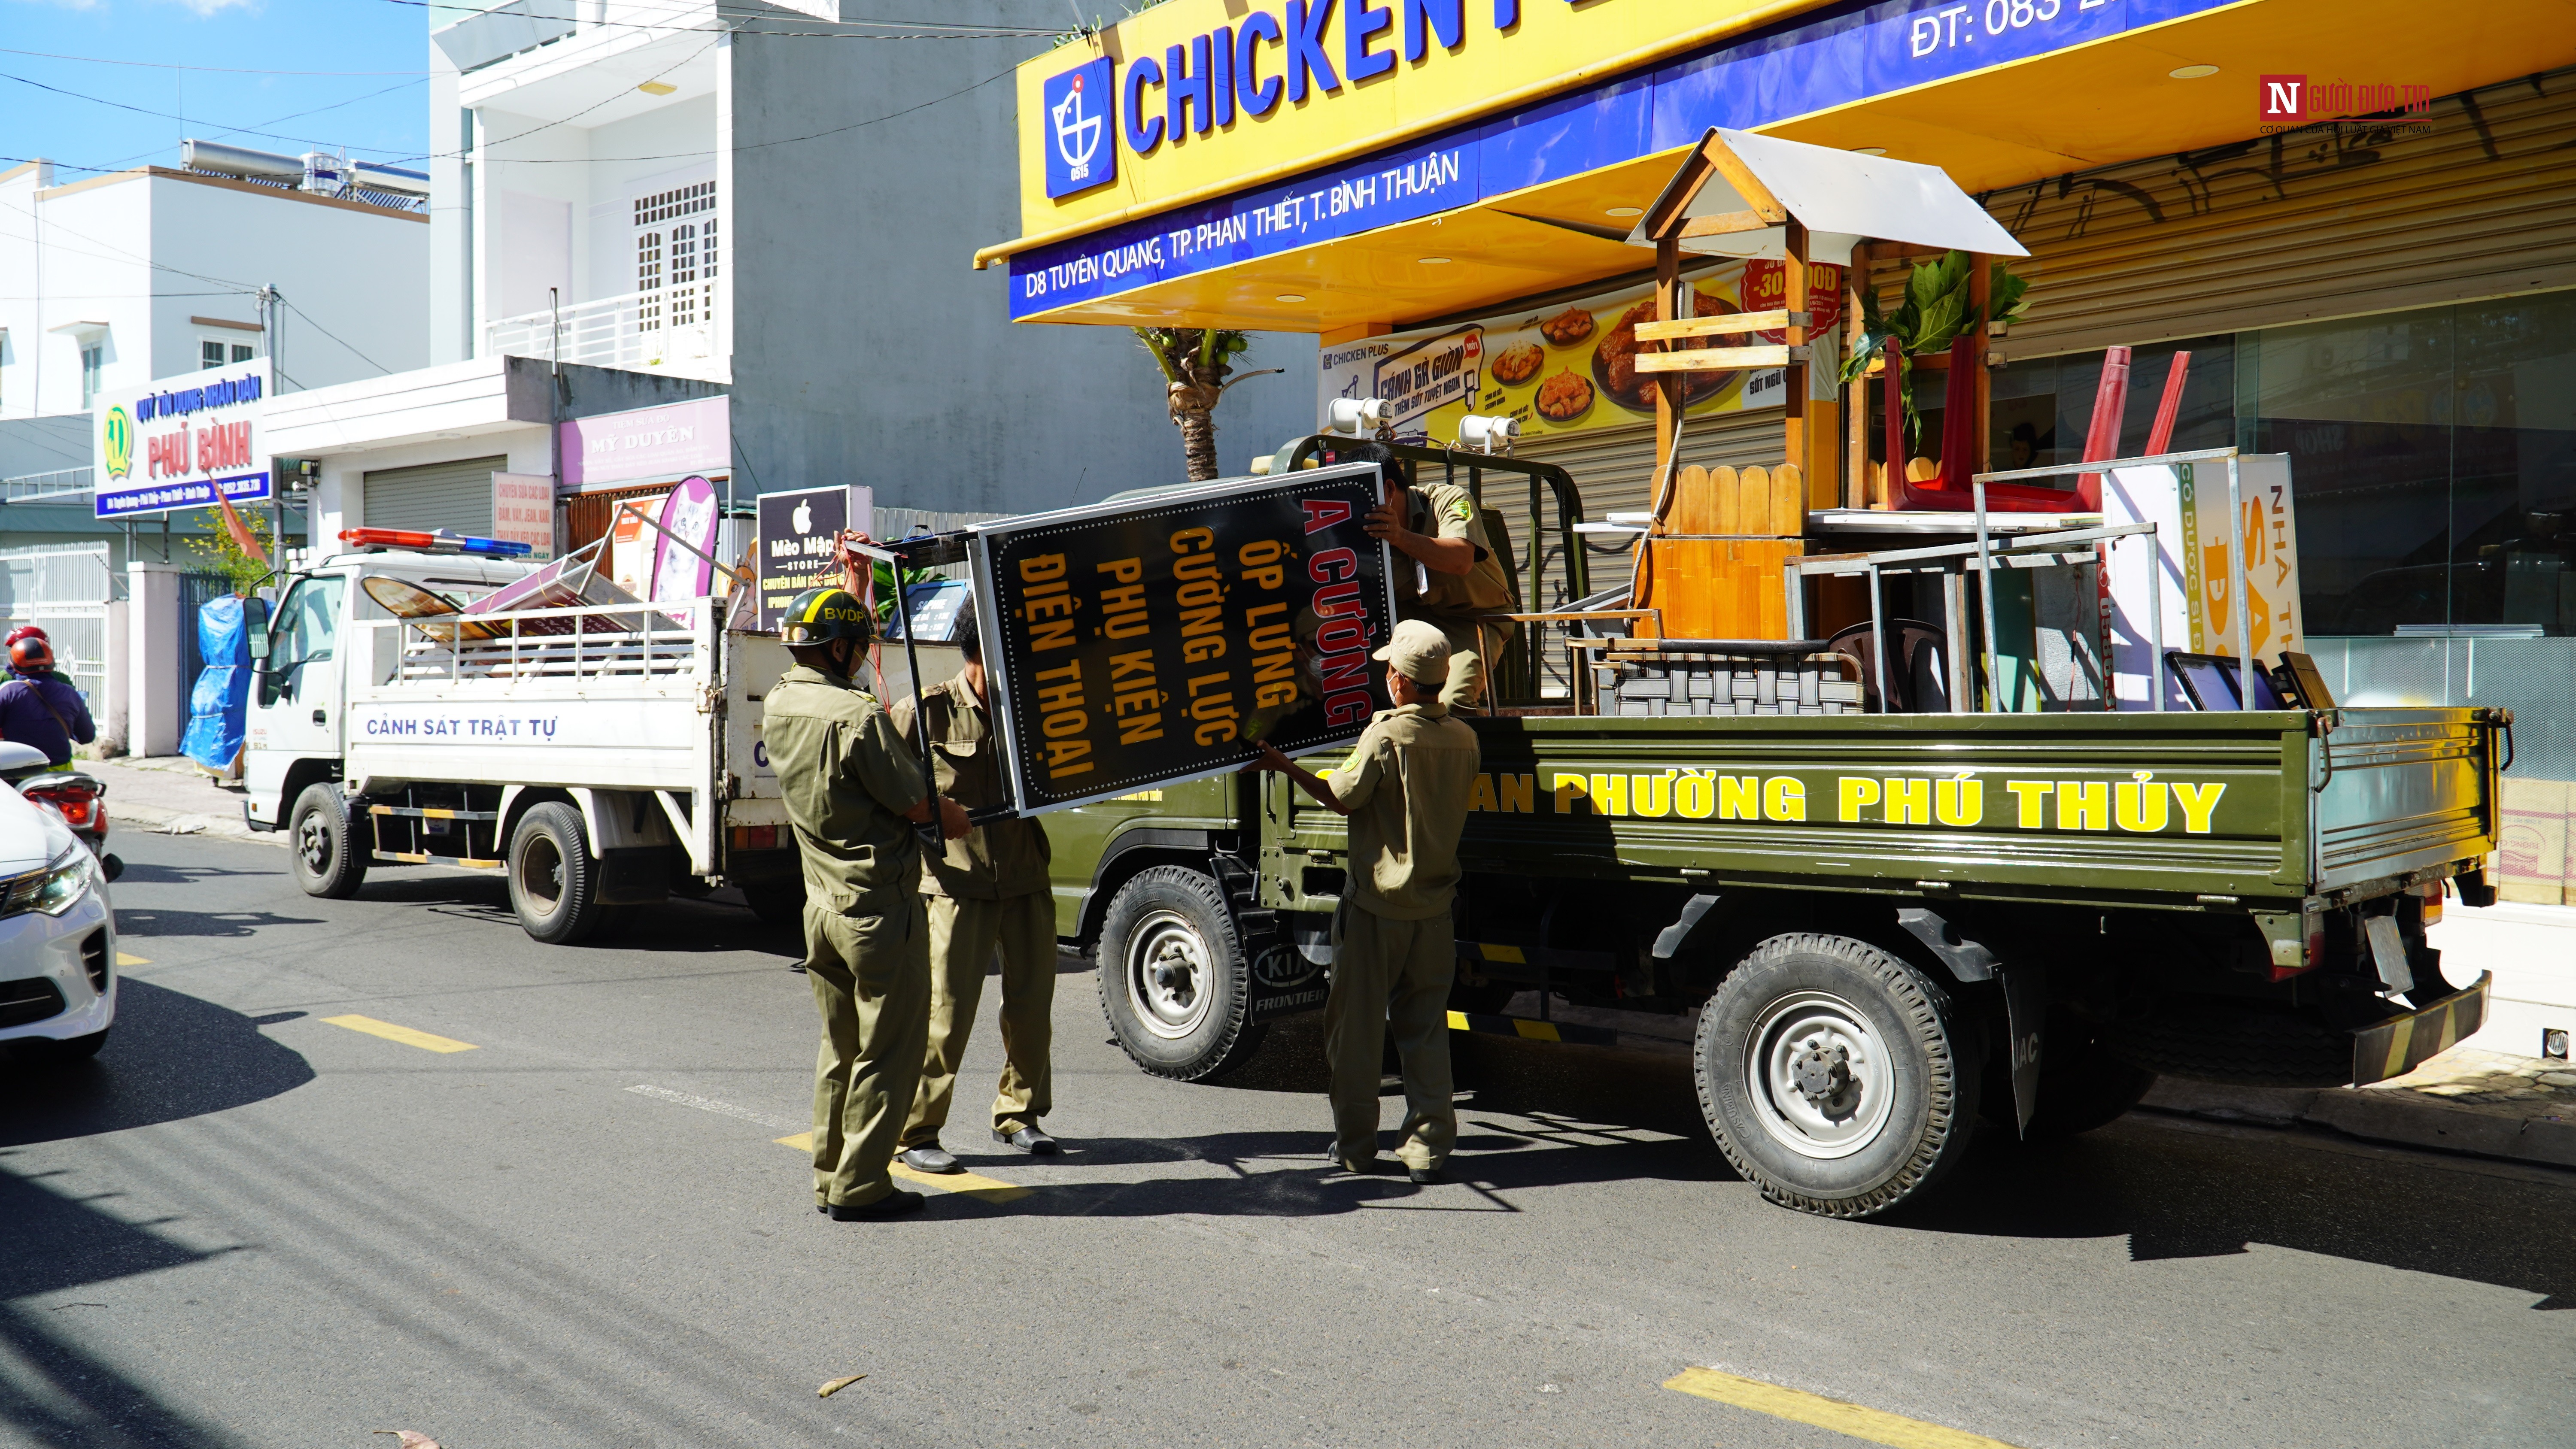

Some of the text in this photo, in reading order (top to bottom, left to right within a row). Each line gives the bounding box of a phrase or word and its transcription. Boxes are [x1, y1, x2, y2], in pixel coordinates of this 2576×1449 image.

[1911, 5, 1973, 58] ĐT:
[1124, 0, 1461, 154] CHICKEN
[1071, 164, 1089, 182] 0515
[1026, 151, 1458, 298] D8 TUYÊN QUANG, TP. PHAN THIẾT, T. BÌNH THUẬN
[1334, 344, 1389, 365] CHICKEN PLUS
[1380, 345, 1464, 400] CÁNH GÀ GIÒN
[1394, 399, 1410, 417] THÊM
[1411, 388, 1424, 411] SỐT
[1424, 383, 1443, 403] TUYỆT
[1443, 375, 1461, 395] NGON
[1750, 375, 1763, 395] SỐT
[1765, 370, 1781, 389] NGŨ
[591, 425, 695, 454] MỸ DUYÊN
[613, 418, 634, 430] TIỆM
[148, 417, 252, 479] PHÚ BÌNH
[1303, 500, 1352, 536] A
[2270, 485, 2291, 589] NHÀ
[772, 536, 834, 557] Mèo Mập
[787, 559, 818, 570] STORE
[2180, 463, 2202, 625] CÓ DƯỢC SĨ
[763, 575, 790, 590] CHUYÊN
[791, 573, 806, 588] BÁN
[824, 608, 864, 622] BVDP
[1170, 526, 1238, 746] CƯỜNG LỰC
[1239, 540, 1298, 709] ỐP LƯNG
[1094, 557, 1168, 745] PHỤ KIỆN
[1308, 546, 1376, 728] CƯỜNG
[2099, 597, 2117, 712] 0586.3
[1015, 553, 1094, 779] ĐIỆN THOẠI
[367, 713, 557, 742] CẢNH SÁT TRẬT TỰ
[1553, 769, 1806, 823] PHƯỜNG
[1839, 771, 1983, 827] PHÚ
[2007, 770, 2227, 834] THỦY
[1267, 953, 1310, 979] KIA
[1255, 988, 1325, 1012] FRONTIER
[2014, 1032, 2038, 1071] JAC
